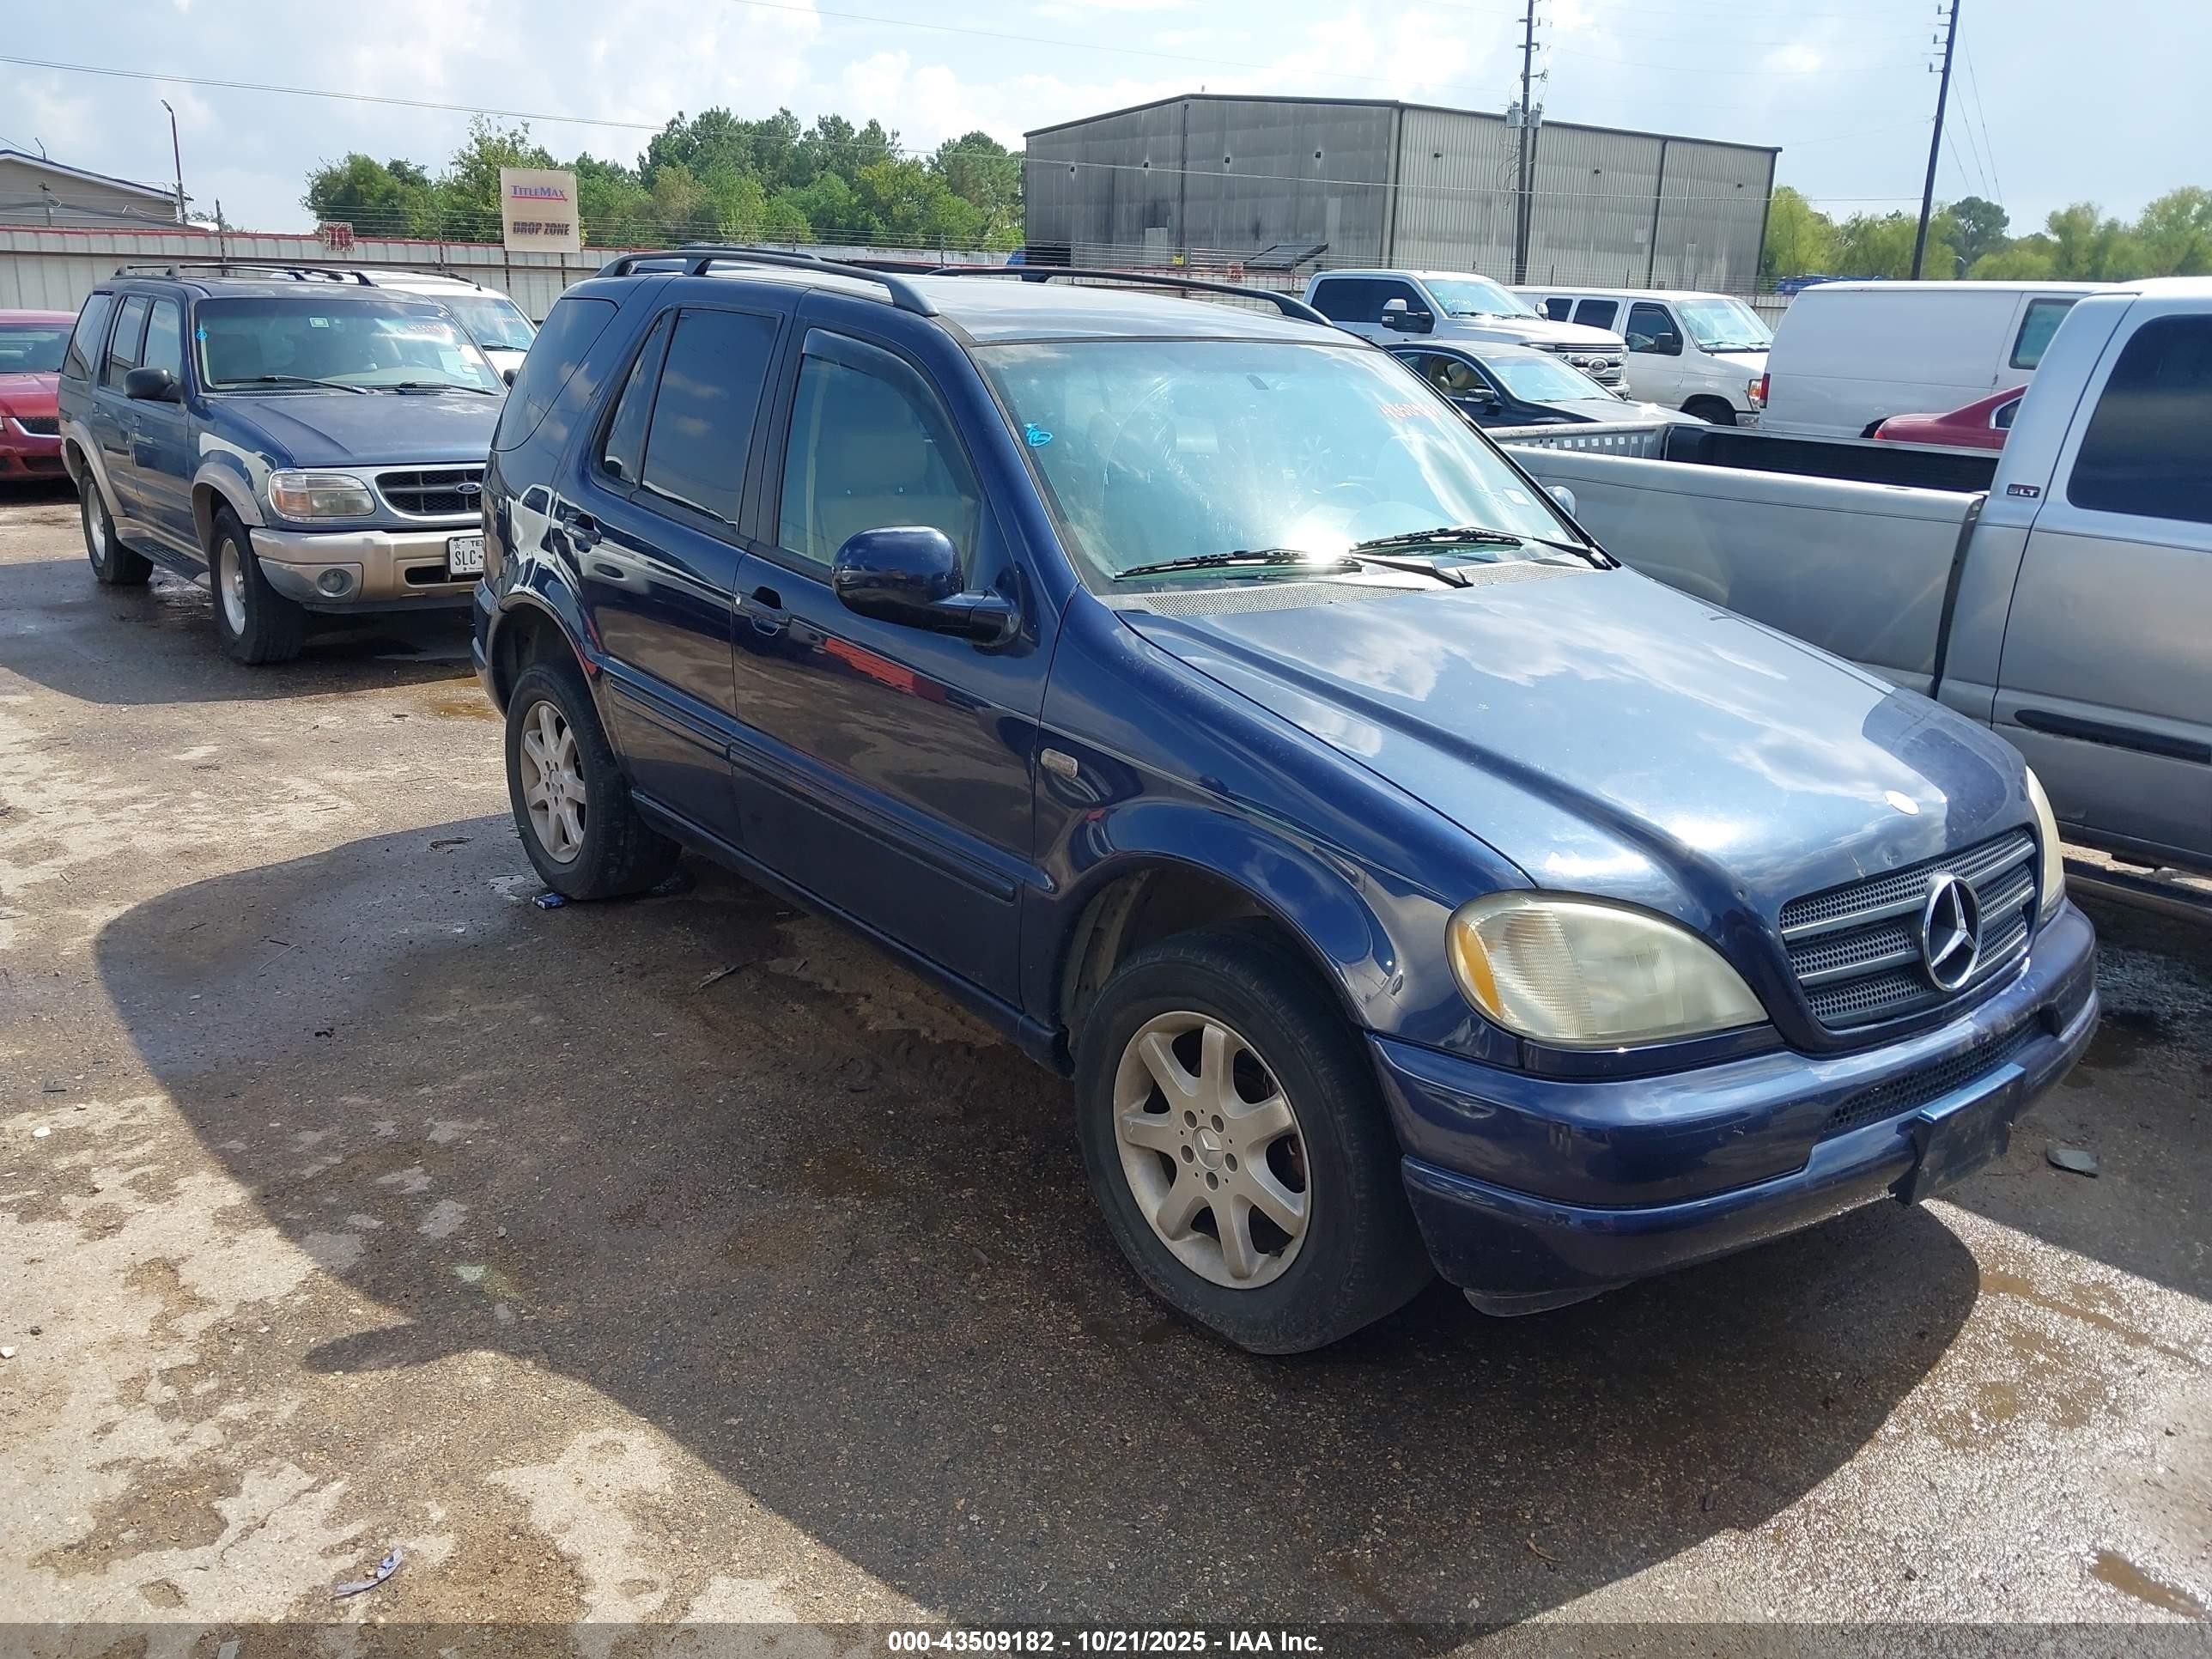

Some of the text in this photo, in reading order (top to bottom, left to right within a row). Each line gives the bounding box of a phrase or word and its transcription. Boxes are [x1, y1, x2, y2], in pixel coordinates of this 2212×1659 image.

[513, 222, 570, 235] DROP ZONE
[2008, 487, 2039, 496] SLT
